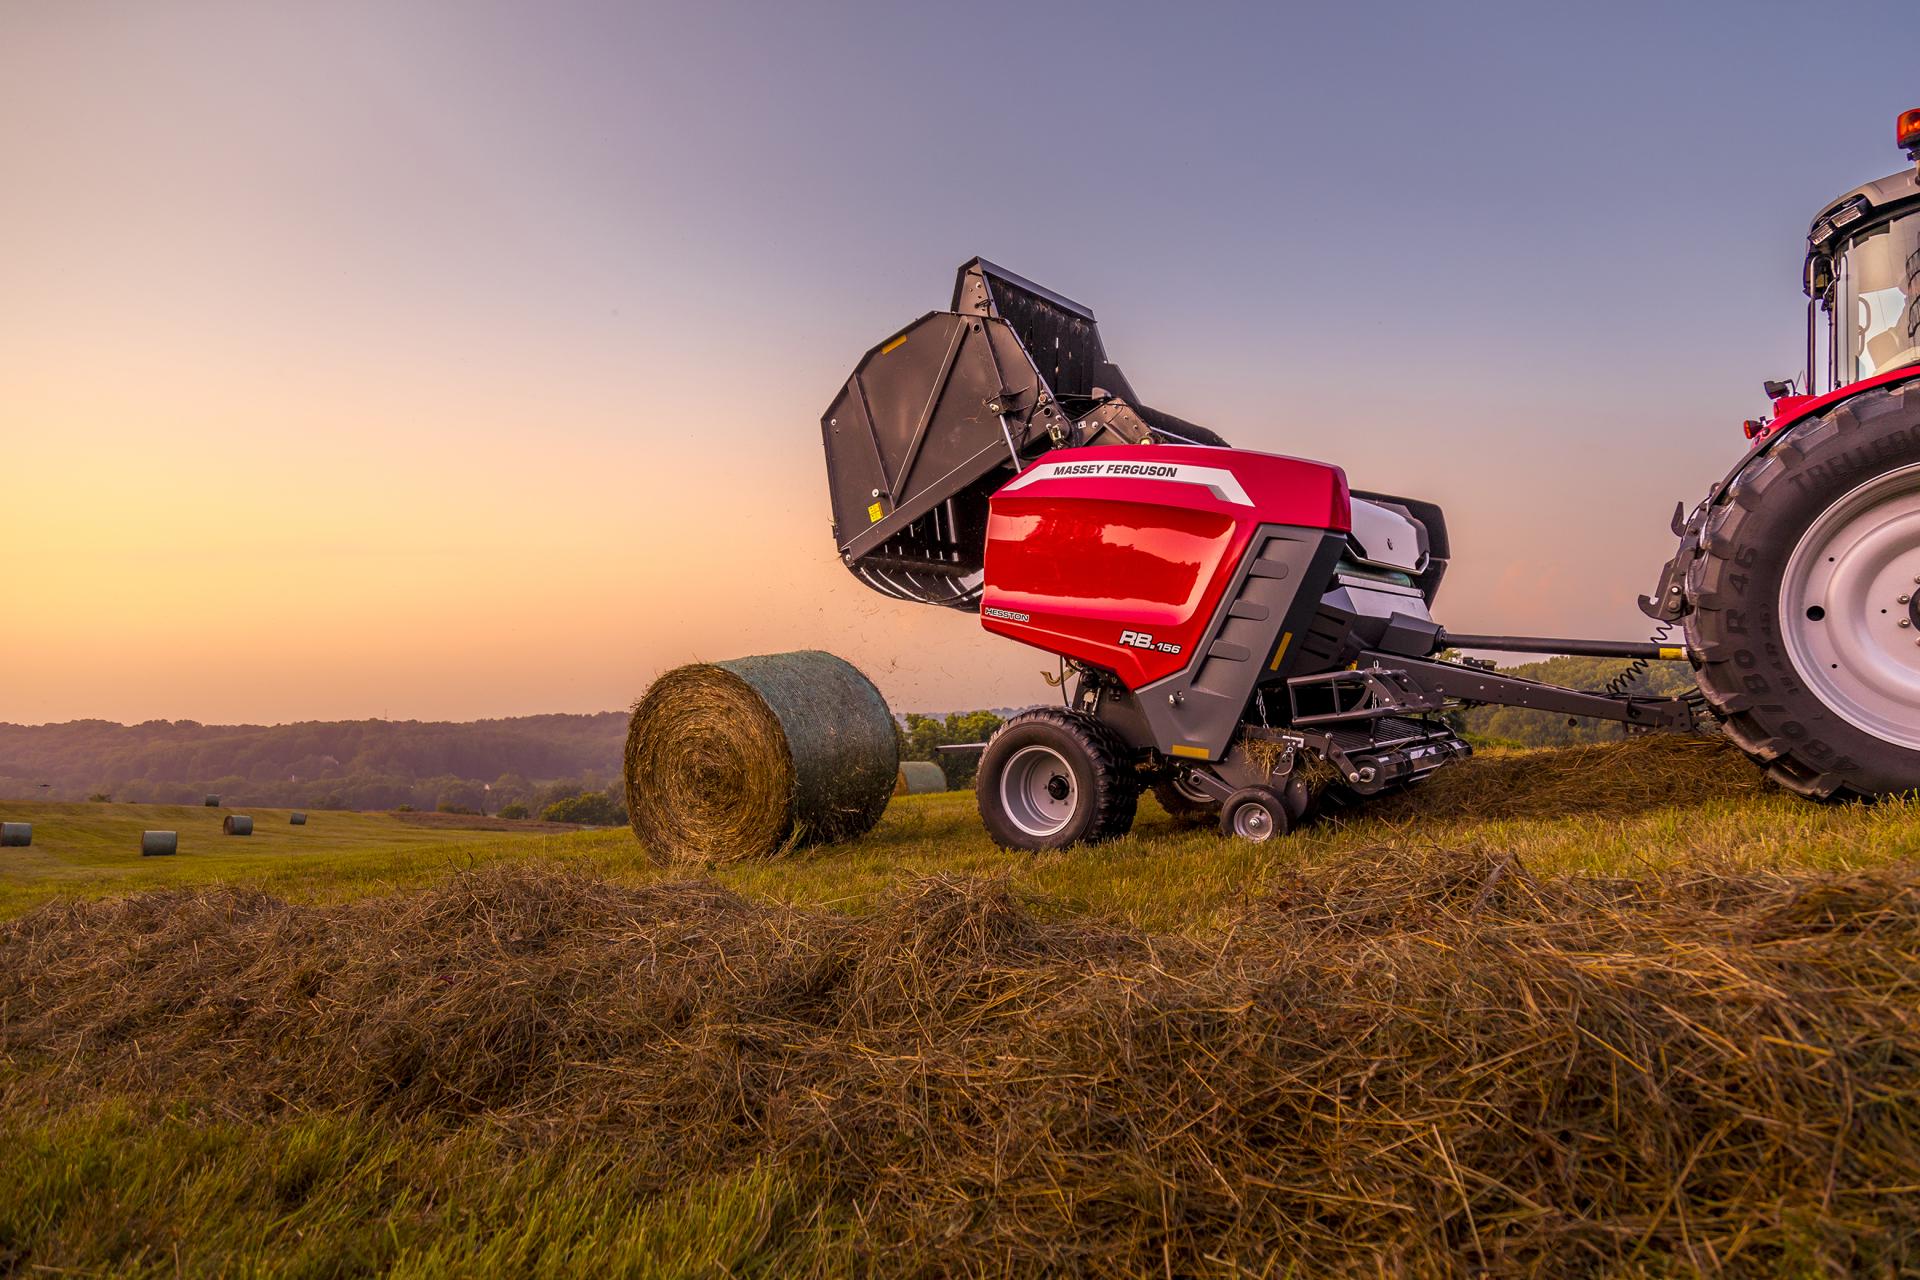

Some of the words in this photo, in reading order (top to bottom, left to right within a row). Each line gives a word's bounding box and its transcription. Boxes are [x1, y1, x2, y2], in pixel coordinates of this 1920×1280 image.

[1053, 464, 1104, 477] MASSEY
[1106, 464, 1178, 478] FERGUSON
[984, 607, 1030, 622] HESSTON
